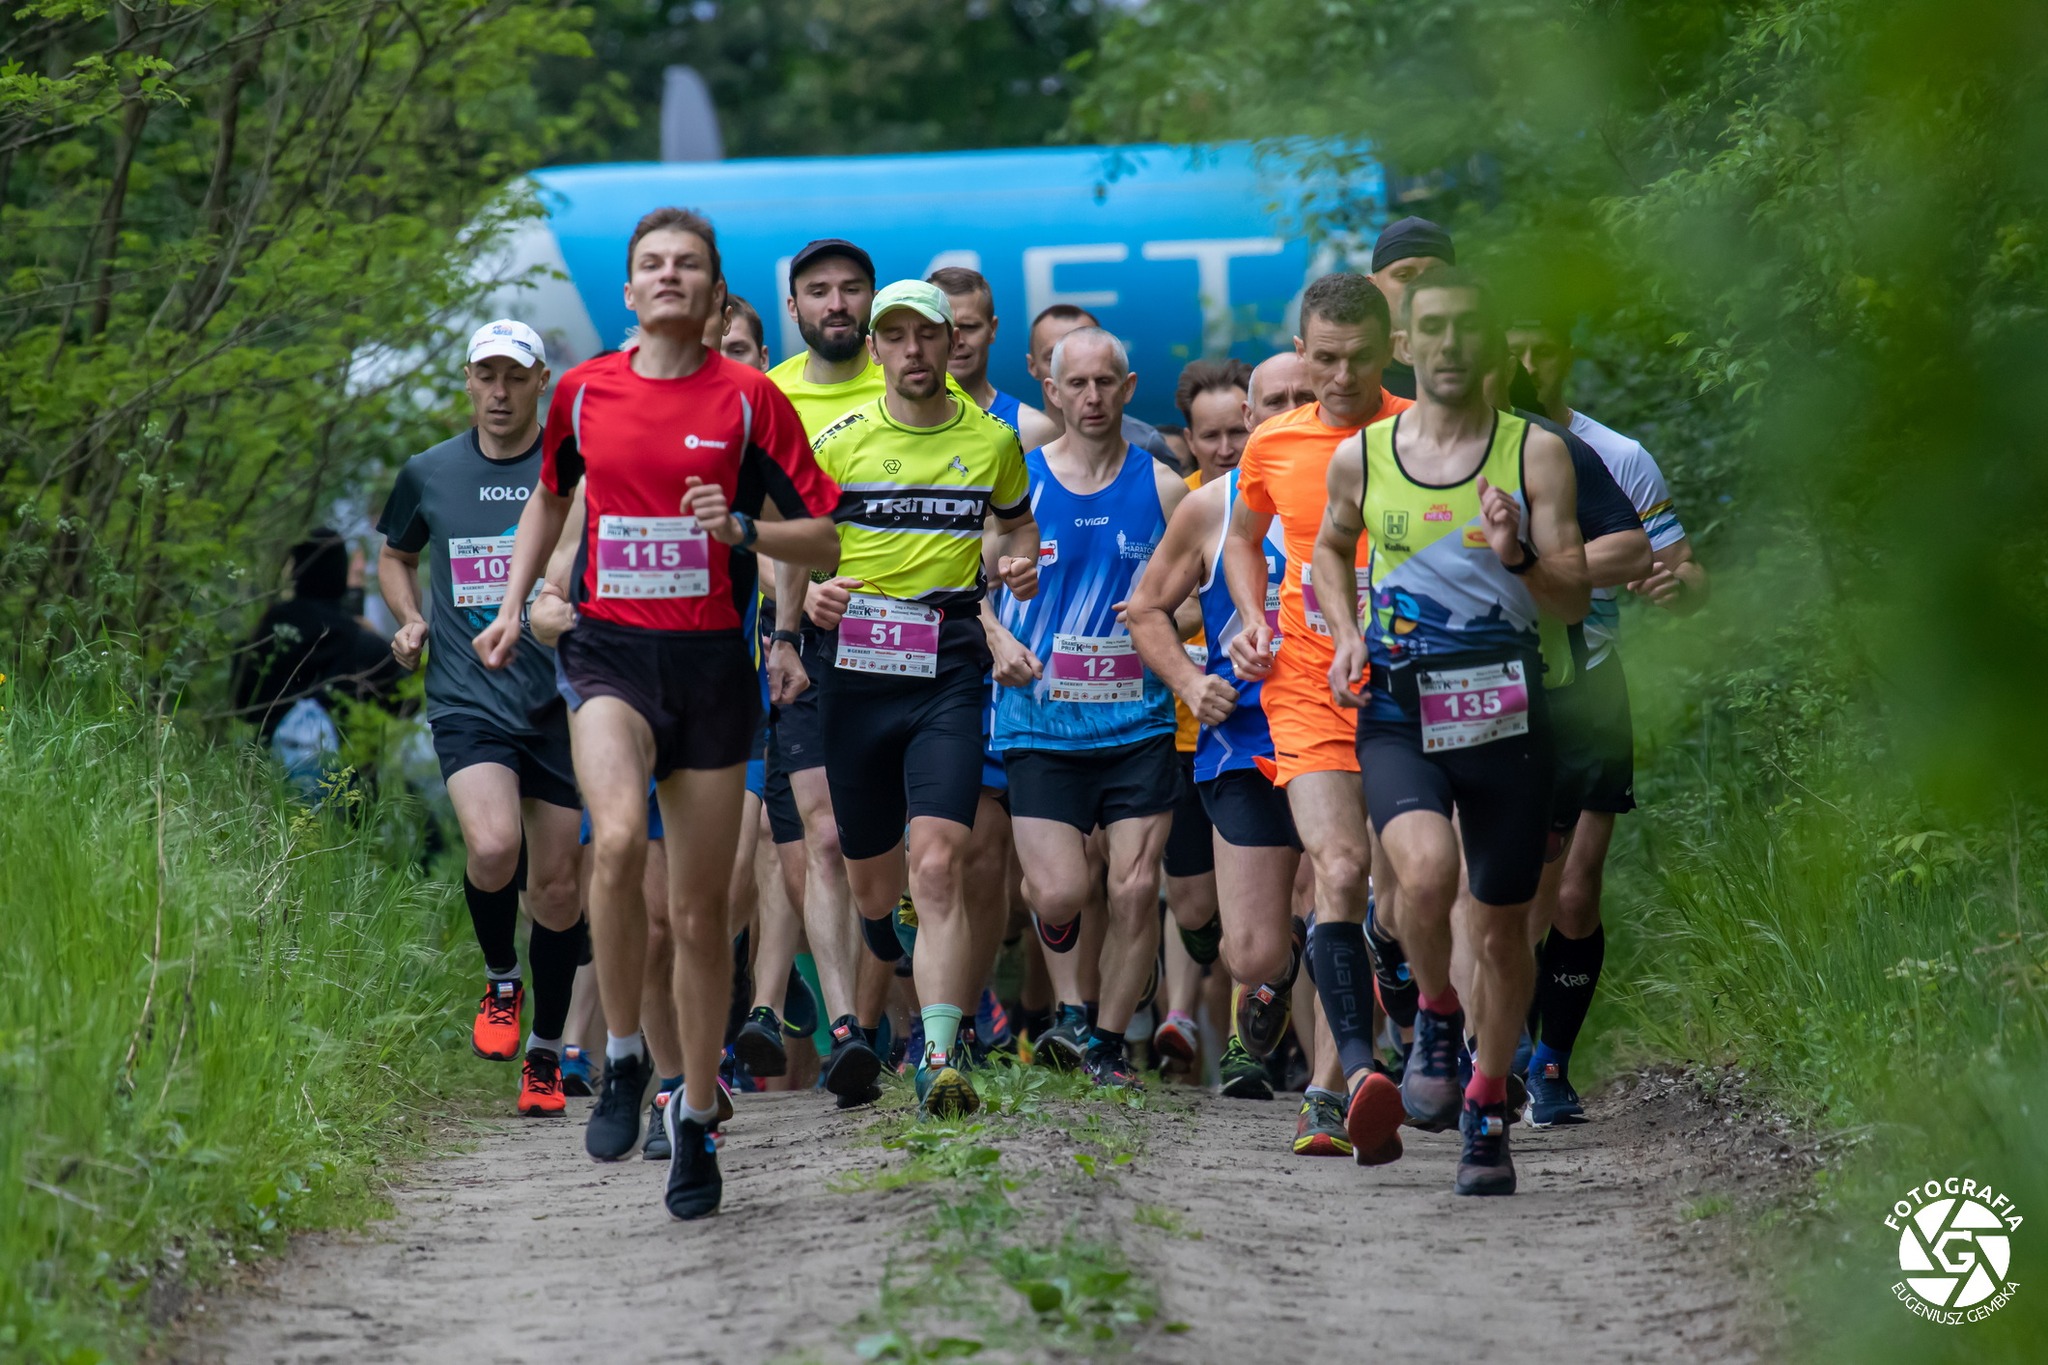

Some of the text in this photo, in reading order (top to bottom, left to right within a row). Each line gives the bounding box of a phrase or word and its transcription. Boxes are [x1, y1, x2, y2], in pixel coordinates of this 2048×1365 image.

[479, 486, 530, 501] KOŁO
[622, 542, 681, 567] 115
[870, 623, 902, 646] 51
[1083, 657, 1116, 677] 12
[1444, 690, 1502, 718] 135
